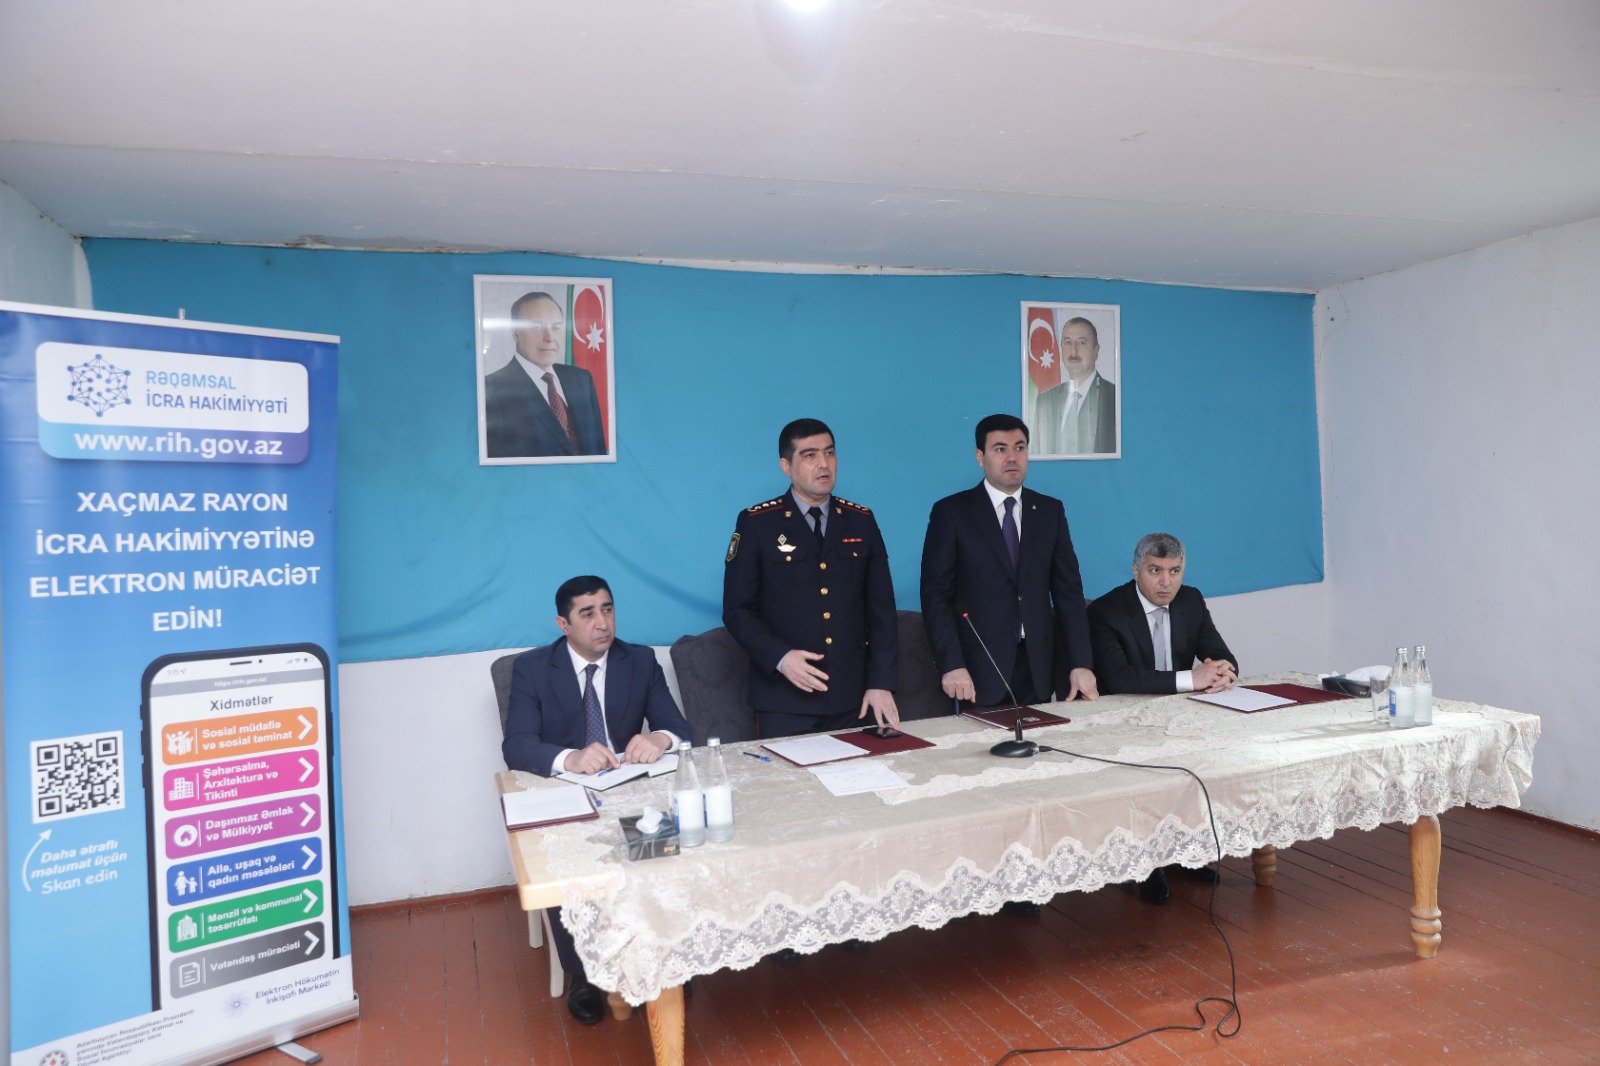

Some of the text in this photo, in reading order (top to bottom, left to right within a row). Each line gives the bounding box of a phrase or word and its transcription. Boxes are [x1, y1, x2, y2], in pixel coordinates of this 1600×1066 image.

[146, 370, 236, 390] RƏQƏMSAL
[146, 389, 288, 414] İCRA HAKİMİYYƏTİ
[74, 432, 283, 459] www.rih.gov.az
[77, 492, 288, 517] XAÇMAZ RAYON
[36, 526, 315, 555] İCRA HAKİMİYYƏTİNƏ
[30, 563, 321, 598] ELEKTRON MÜRACİƏT
[153, 606, 223, 632] EDİN!
[210, 695, 274, 711] Xidmətlər
[202, 720, 282, 738] Sosial müdafiə
[202, 731, 293, 751] və sosial təminat
[203, 771, 279, 790] Arxitektura və
[203, 788, 238, 801] Tikinti
[205, 806, 294, 830] Daşınmaz Əmlak
[205, 821, 273, 841] və Mülkiyyət
[30, 852, 128, 879] məlumat üçün
[41, 849, 77, 864] Daha
[235, 857, 262, 871] uşaq
[263, 855, 277, 863] və
[41, 869, 118, 895] Skan edin
[207, 860, 295, 889] qadın məsələləri
[207, 893, 303, 923] Mənzil və kommunal
[255, 982, 293, 999] Elektron
